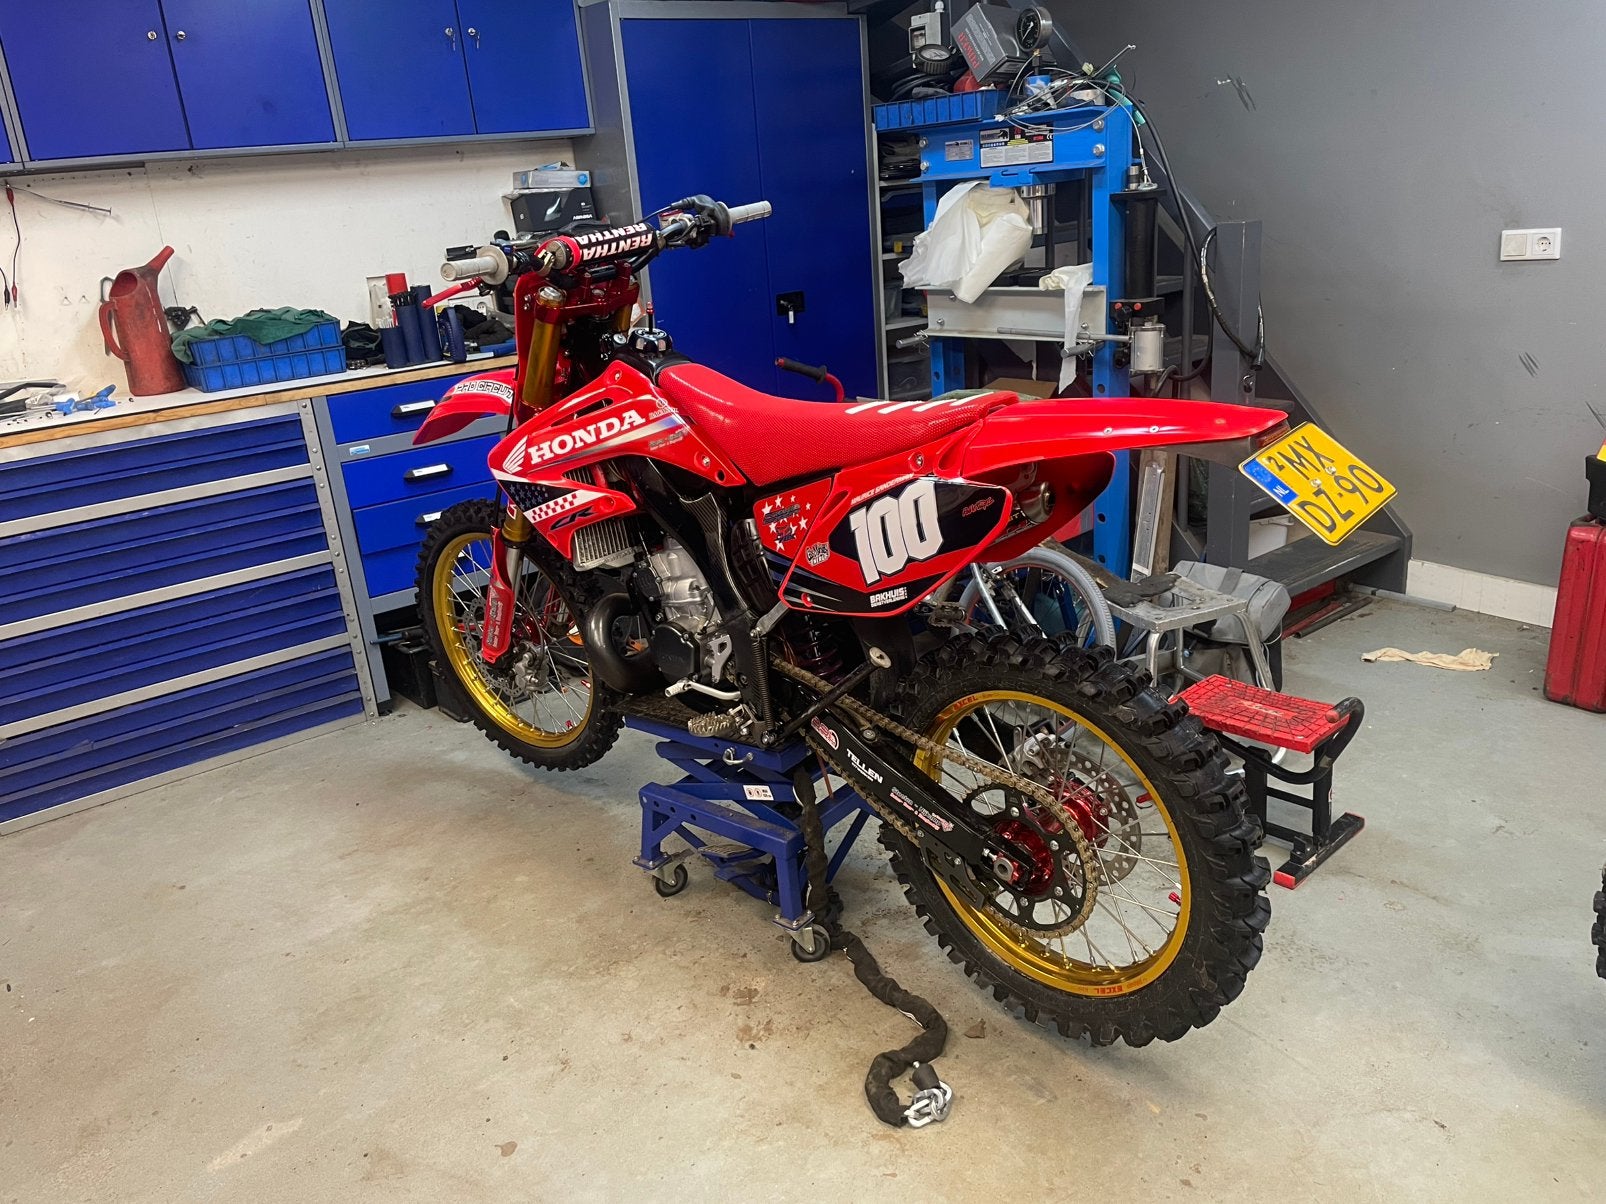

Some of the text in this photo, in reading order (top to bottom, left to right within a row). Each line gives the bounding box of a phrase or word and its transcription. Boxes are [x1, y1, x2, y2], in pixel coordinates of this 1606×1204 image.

[572, 223, 648, 245] RENTHA
[580, 233, 653, 260] RENTHA
[527, 409, 646, 465] HONDA
[1296, 464, 1384, 534] DZ-90
[550, 505, 598, 531] CR
[849, 479, 943, 586] 100
[870, 587, 905, 604] BAKHUIS
[846, 748, 884, 784] TELLEN
